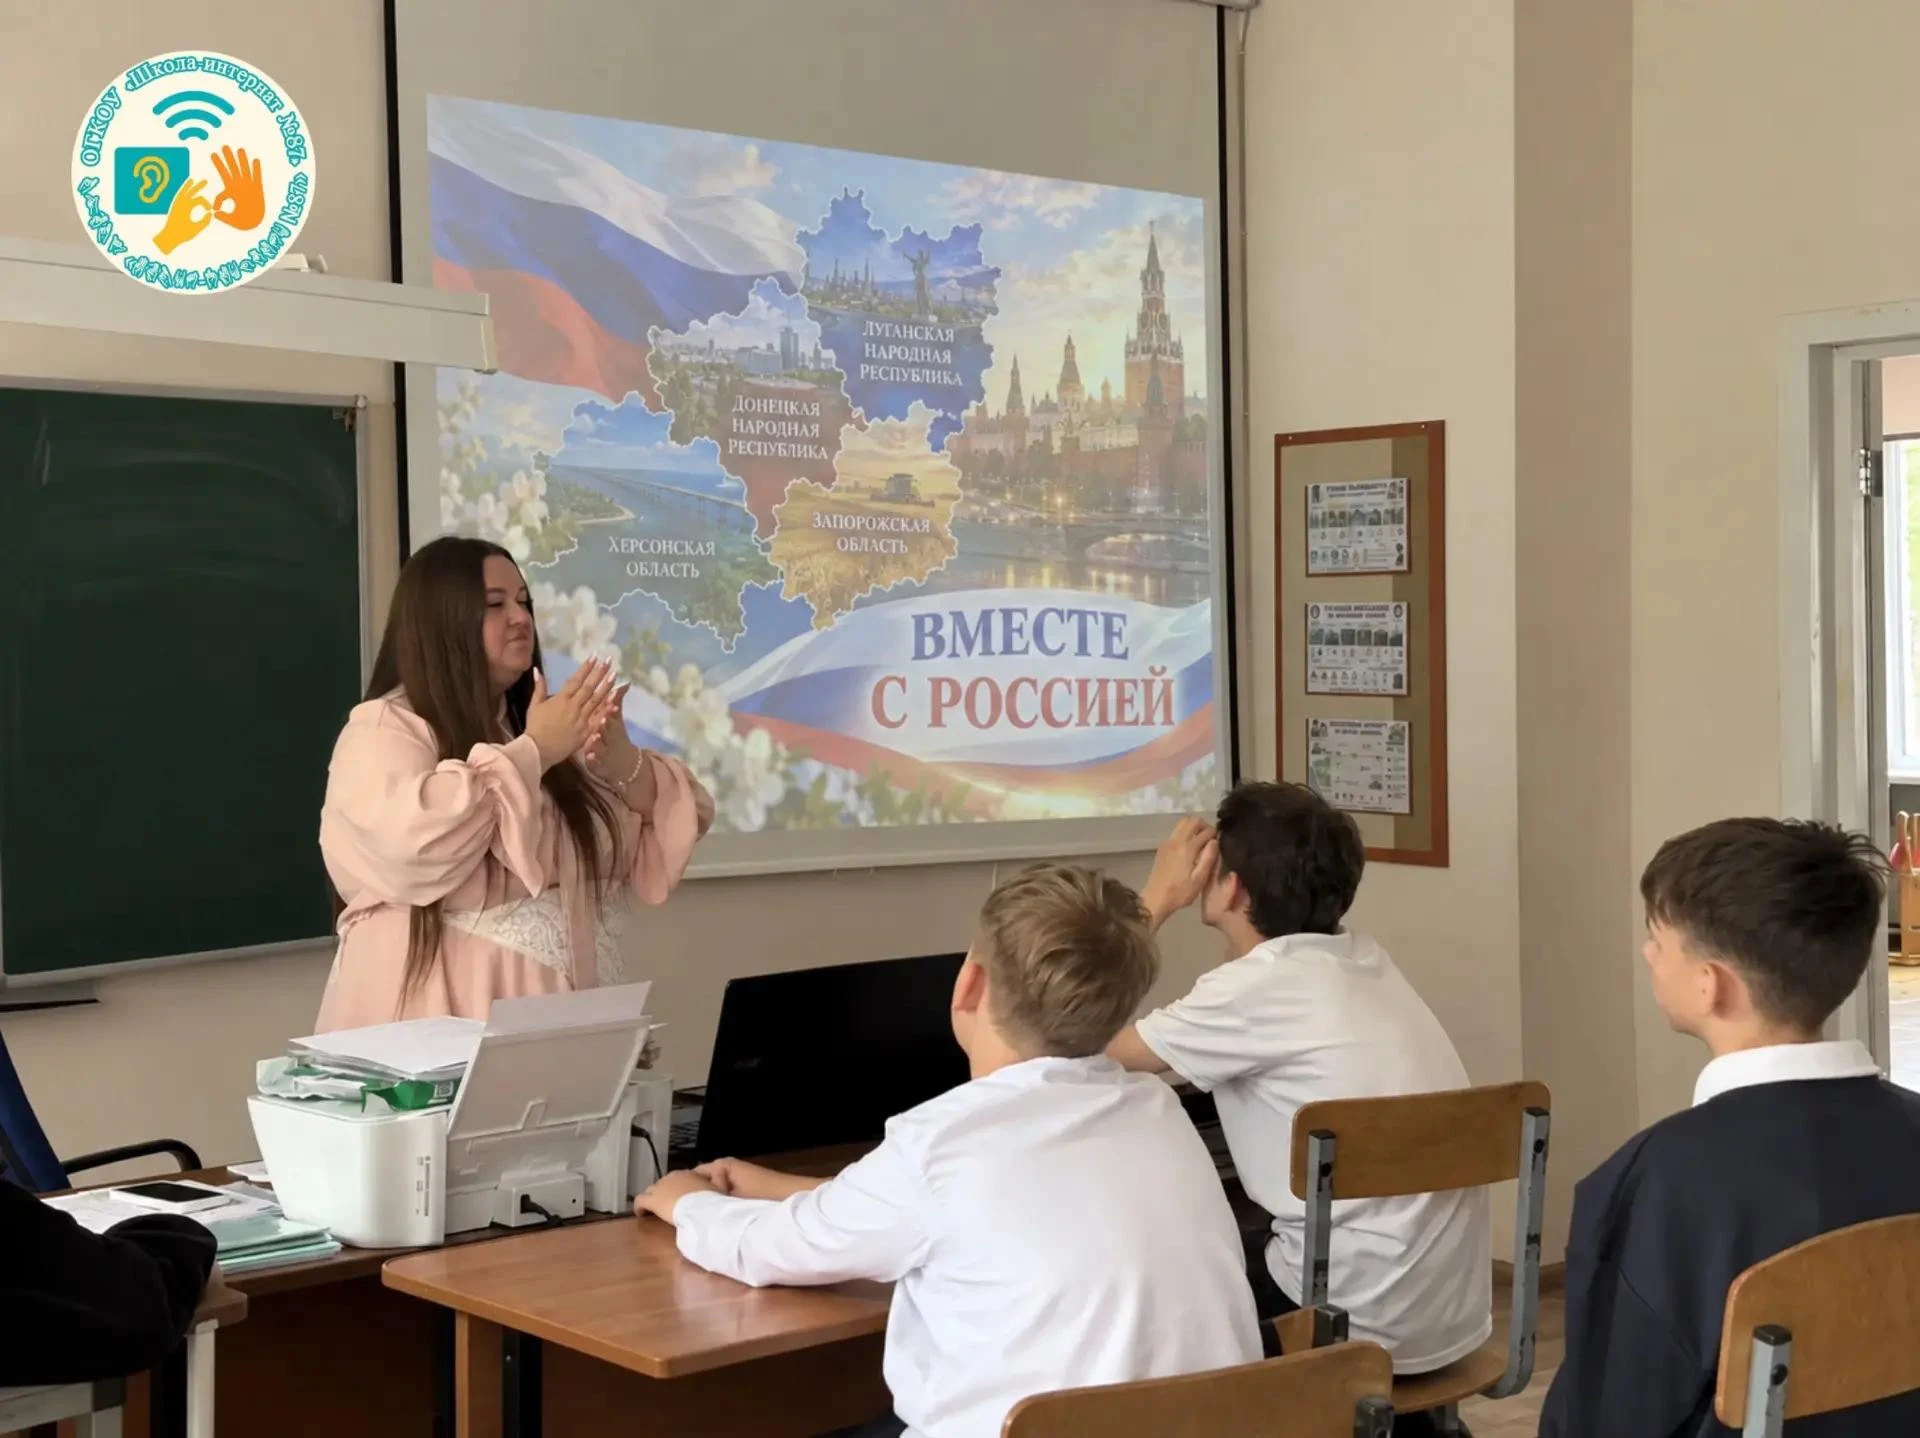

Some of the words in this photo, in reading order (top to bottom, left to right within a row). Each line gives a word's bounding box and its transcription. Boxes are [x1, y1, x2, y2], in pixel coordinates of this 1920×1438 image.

[862, 320, 955, 343] ЛУГАНСКАЯ
[864, 343, 952, 364] НАРОДНАЯ
[860, 364, 963, 387] РЕСПУБЛИКА
[732, 395, 820, 417] ДОНЕЦКАЯ
[732, 418, 820, 438] НАРОДНАЯ
[728, 439, 828, 460] РЕСПУБЛИКА
[812, 512, 931, 533] ЗАПОРОЖСКАЯ
[608, 536, 716, 556] ХЕРСОНСКАЯ
[836, 537, 909, 554] ОБЛАСТЬ
[626, 561, 700, 578] ОБЛАСТЬ
[911, 607, 1130, 661] ВМЕСТЕ
[871, 675, 908, 729] С
[927, 666, 1175, 729] РОССИЕЙ
